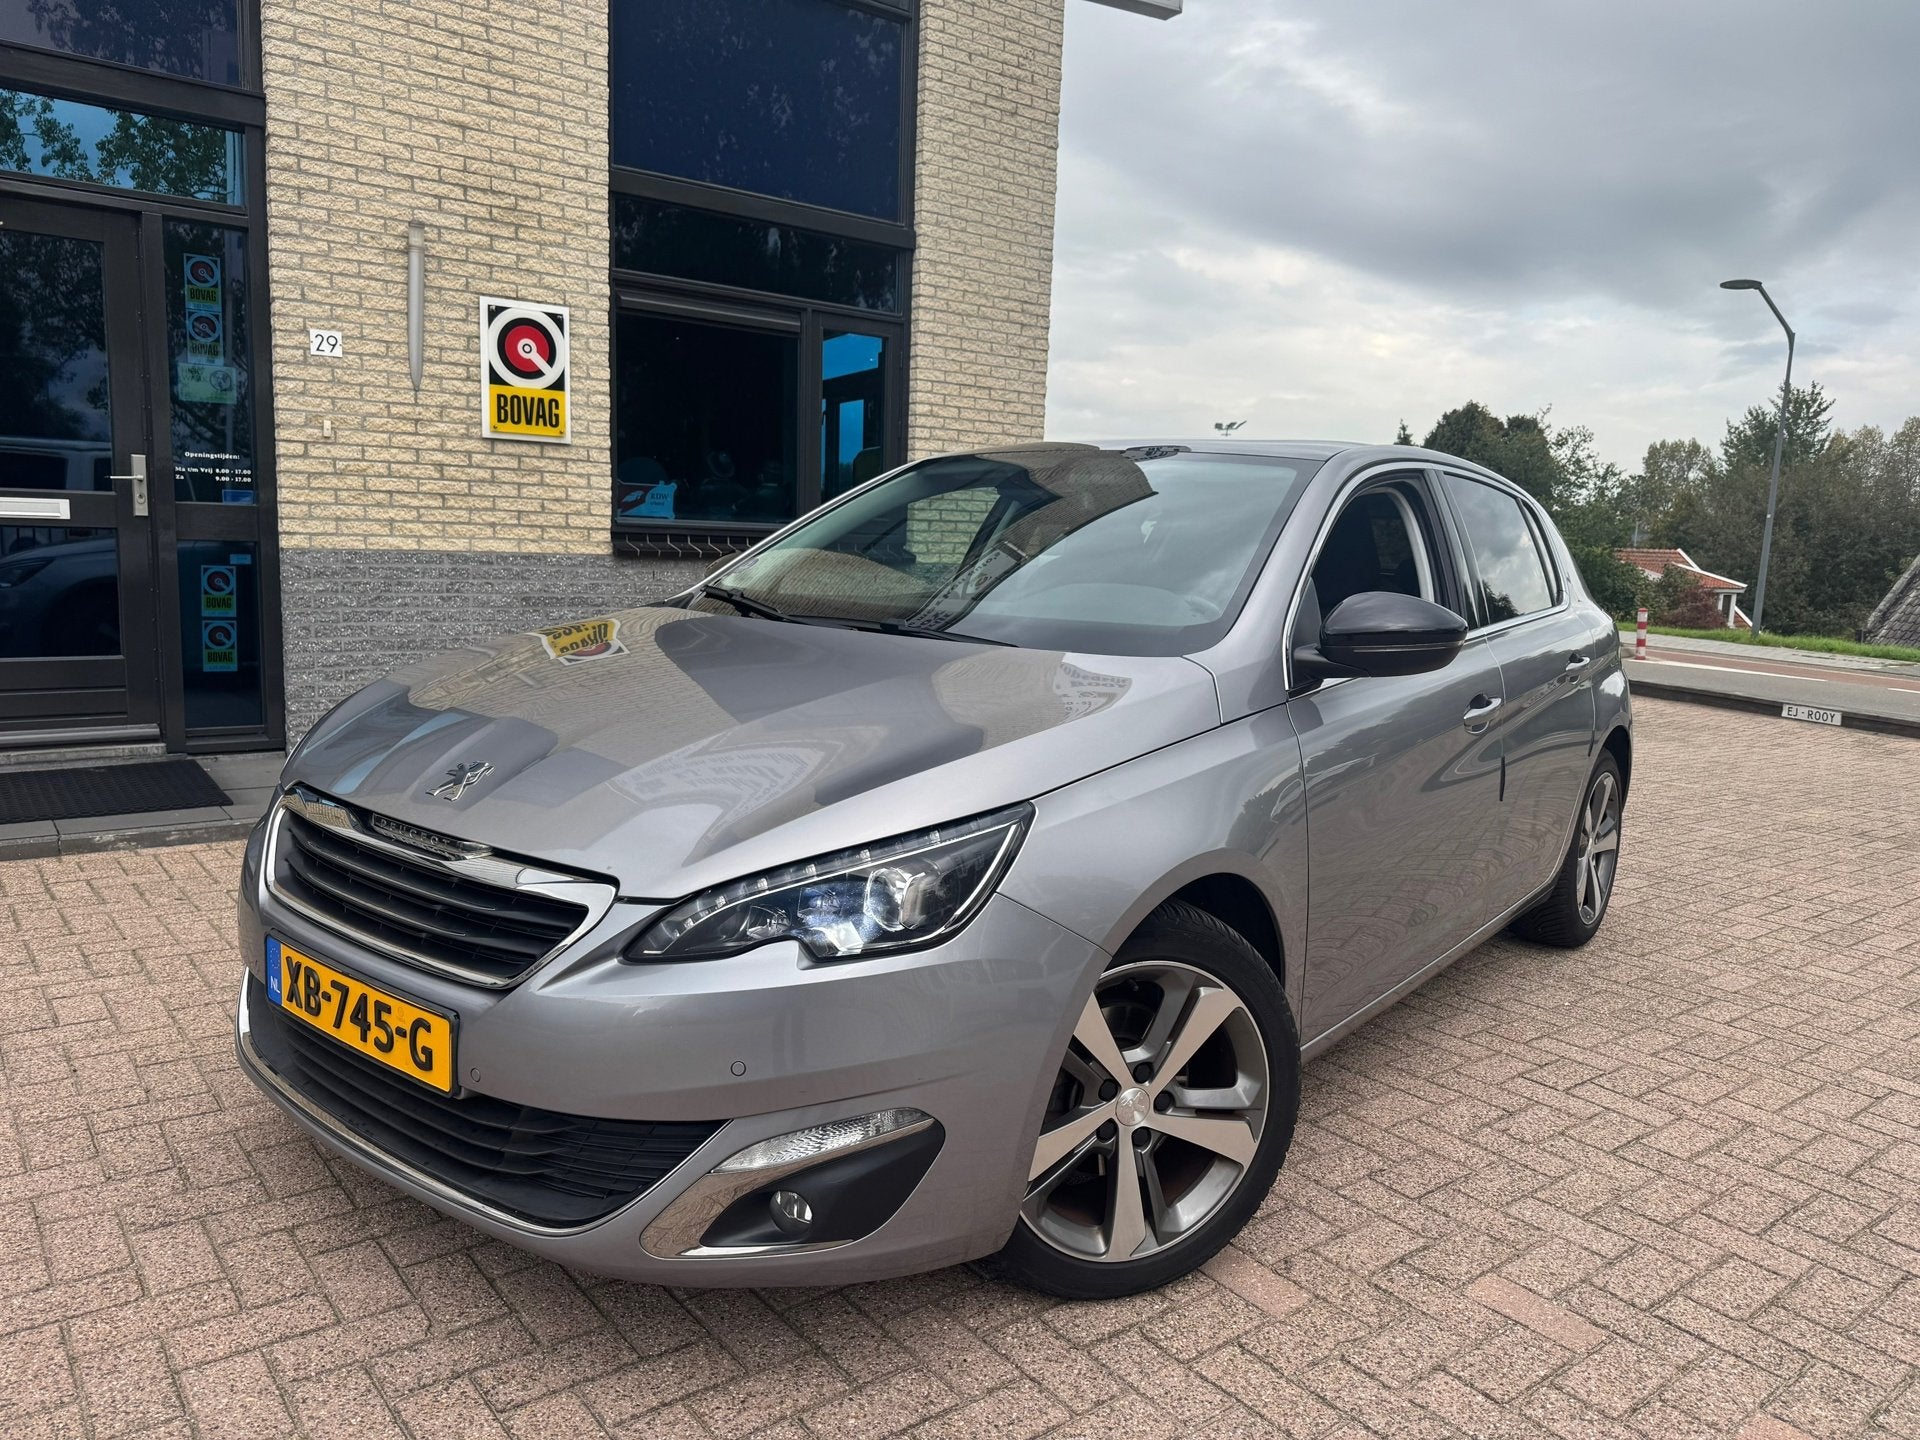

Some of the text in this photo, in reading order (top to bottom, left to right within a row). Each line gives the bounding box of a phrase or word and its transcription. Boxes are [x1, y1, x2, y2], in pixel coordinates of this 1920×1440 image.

[190, 287, 217, 303] BOVAG
[315, 333, 339, 354] 29
[496, 393, 560, 428] BOVAG
[206, 597, 232, 609] BOVAG
[269, 975, 281, 994] NL
[285, 956, 433, 1072] XB-745-G
